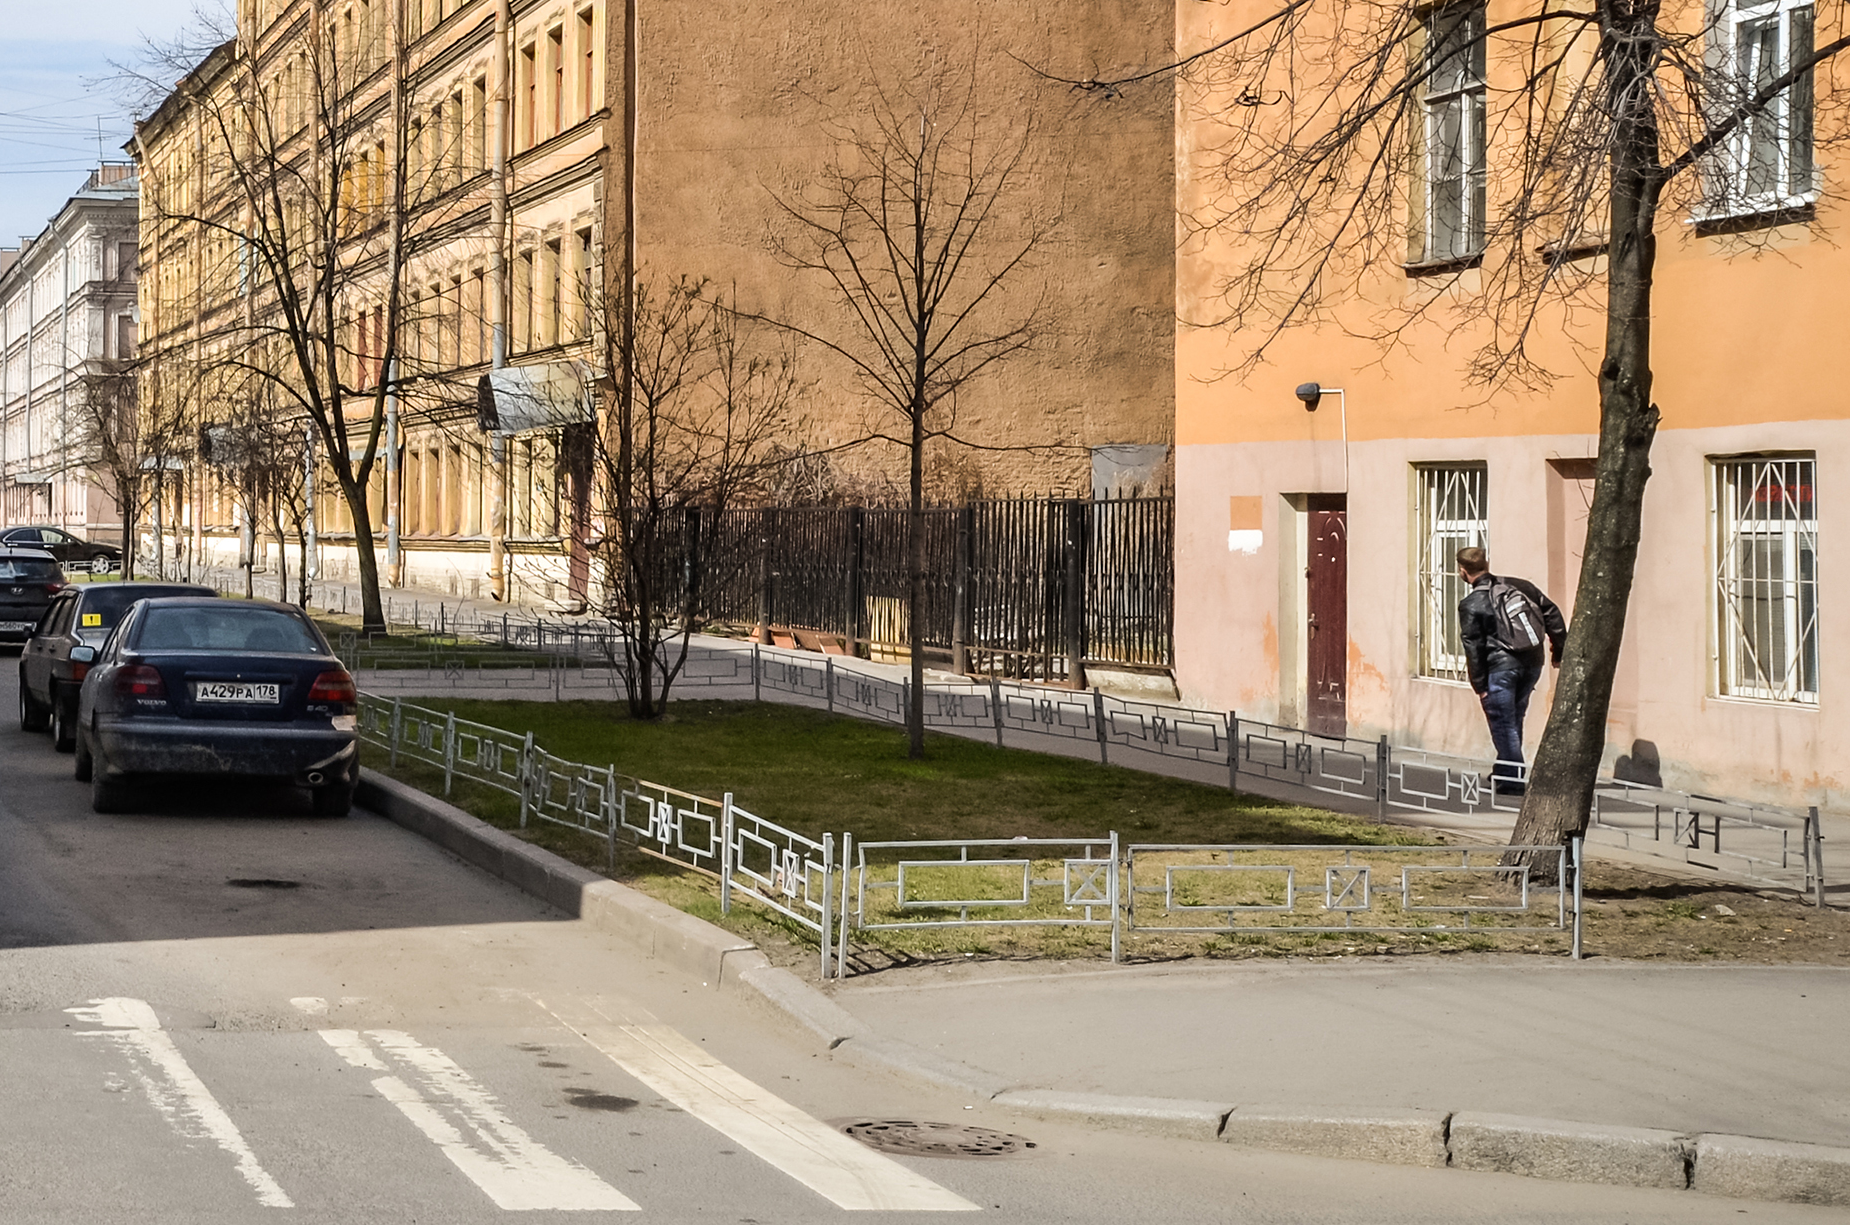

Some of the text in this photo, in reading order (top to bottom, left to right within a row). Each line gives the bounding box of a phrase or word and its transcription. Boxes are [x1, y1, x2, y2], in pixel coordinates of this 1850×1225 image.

[201, 684, 276, 699] А429РА 178
[136, 698, 167, 706] VOLVO
